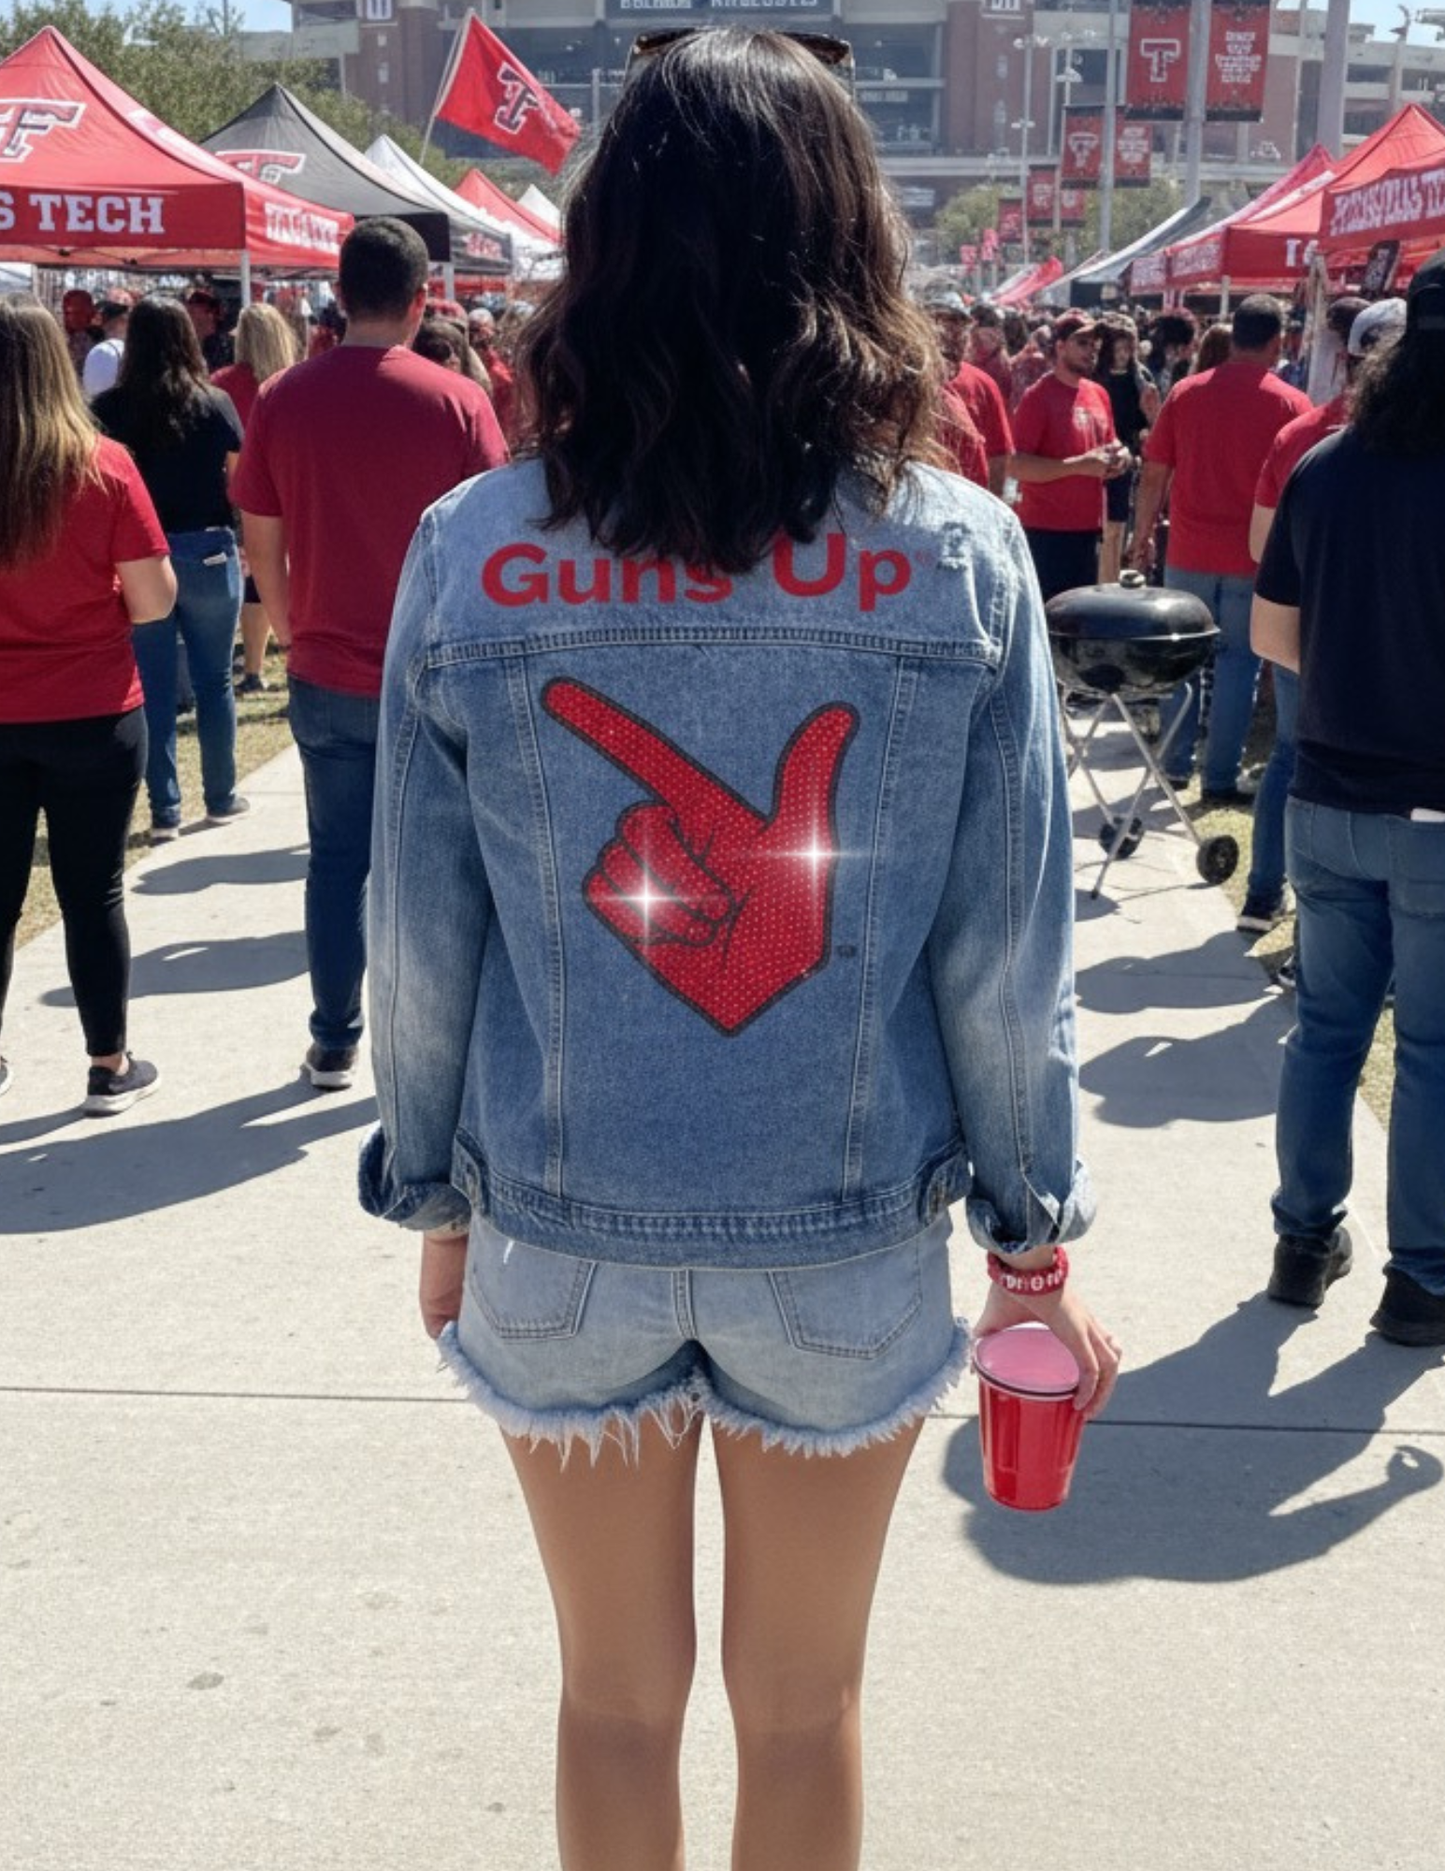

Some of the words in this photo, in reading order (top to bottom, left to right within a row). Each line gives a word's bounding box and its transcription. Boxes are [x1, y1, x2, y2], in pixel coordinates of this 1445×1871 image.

[28, 193, 165, 234] TECH
[481, 542, 734, 607] Guns
[772, 530, 912, 612] Up
